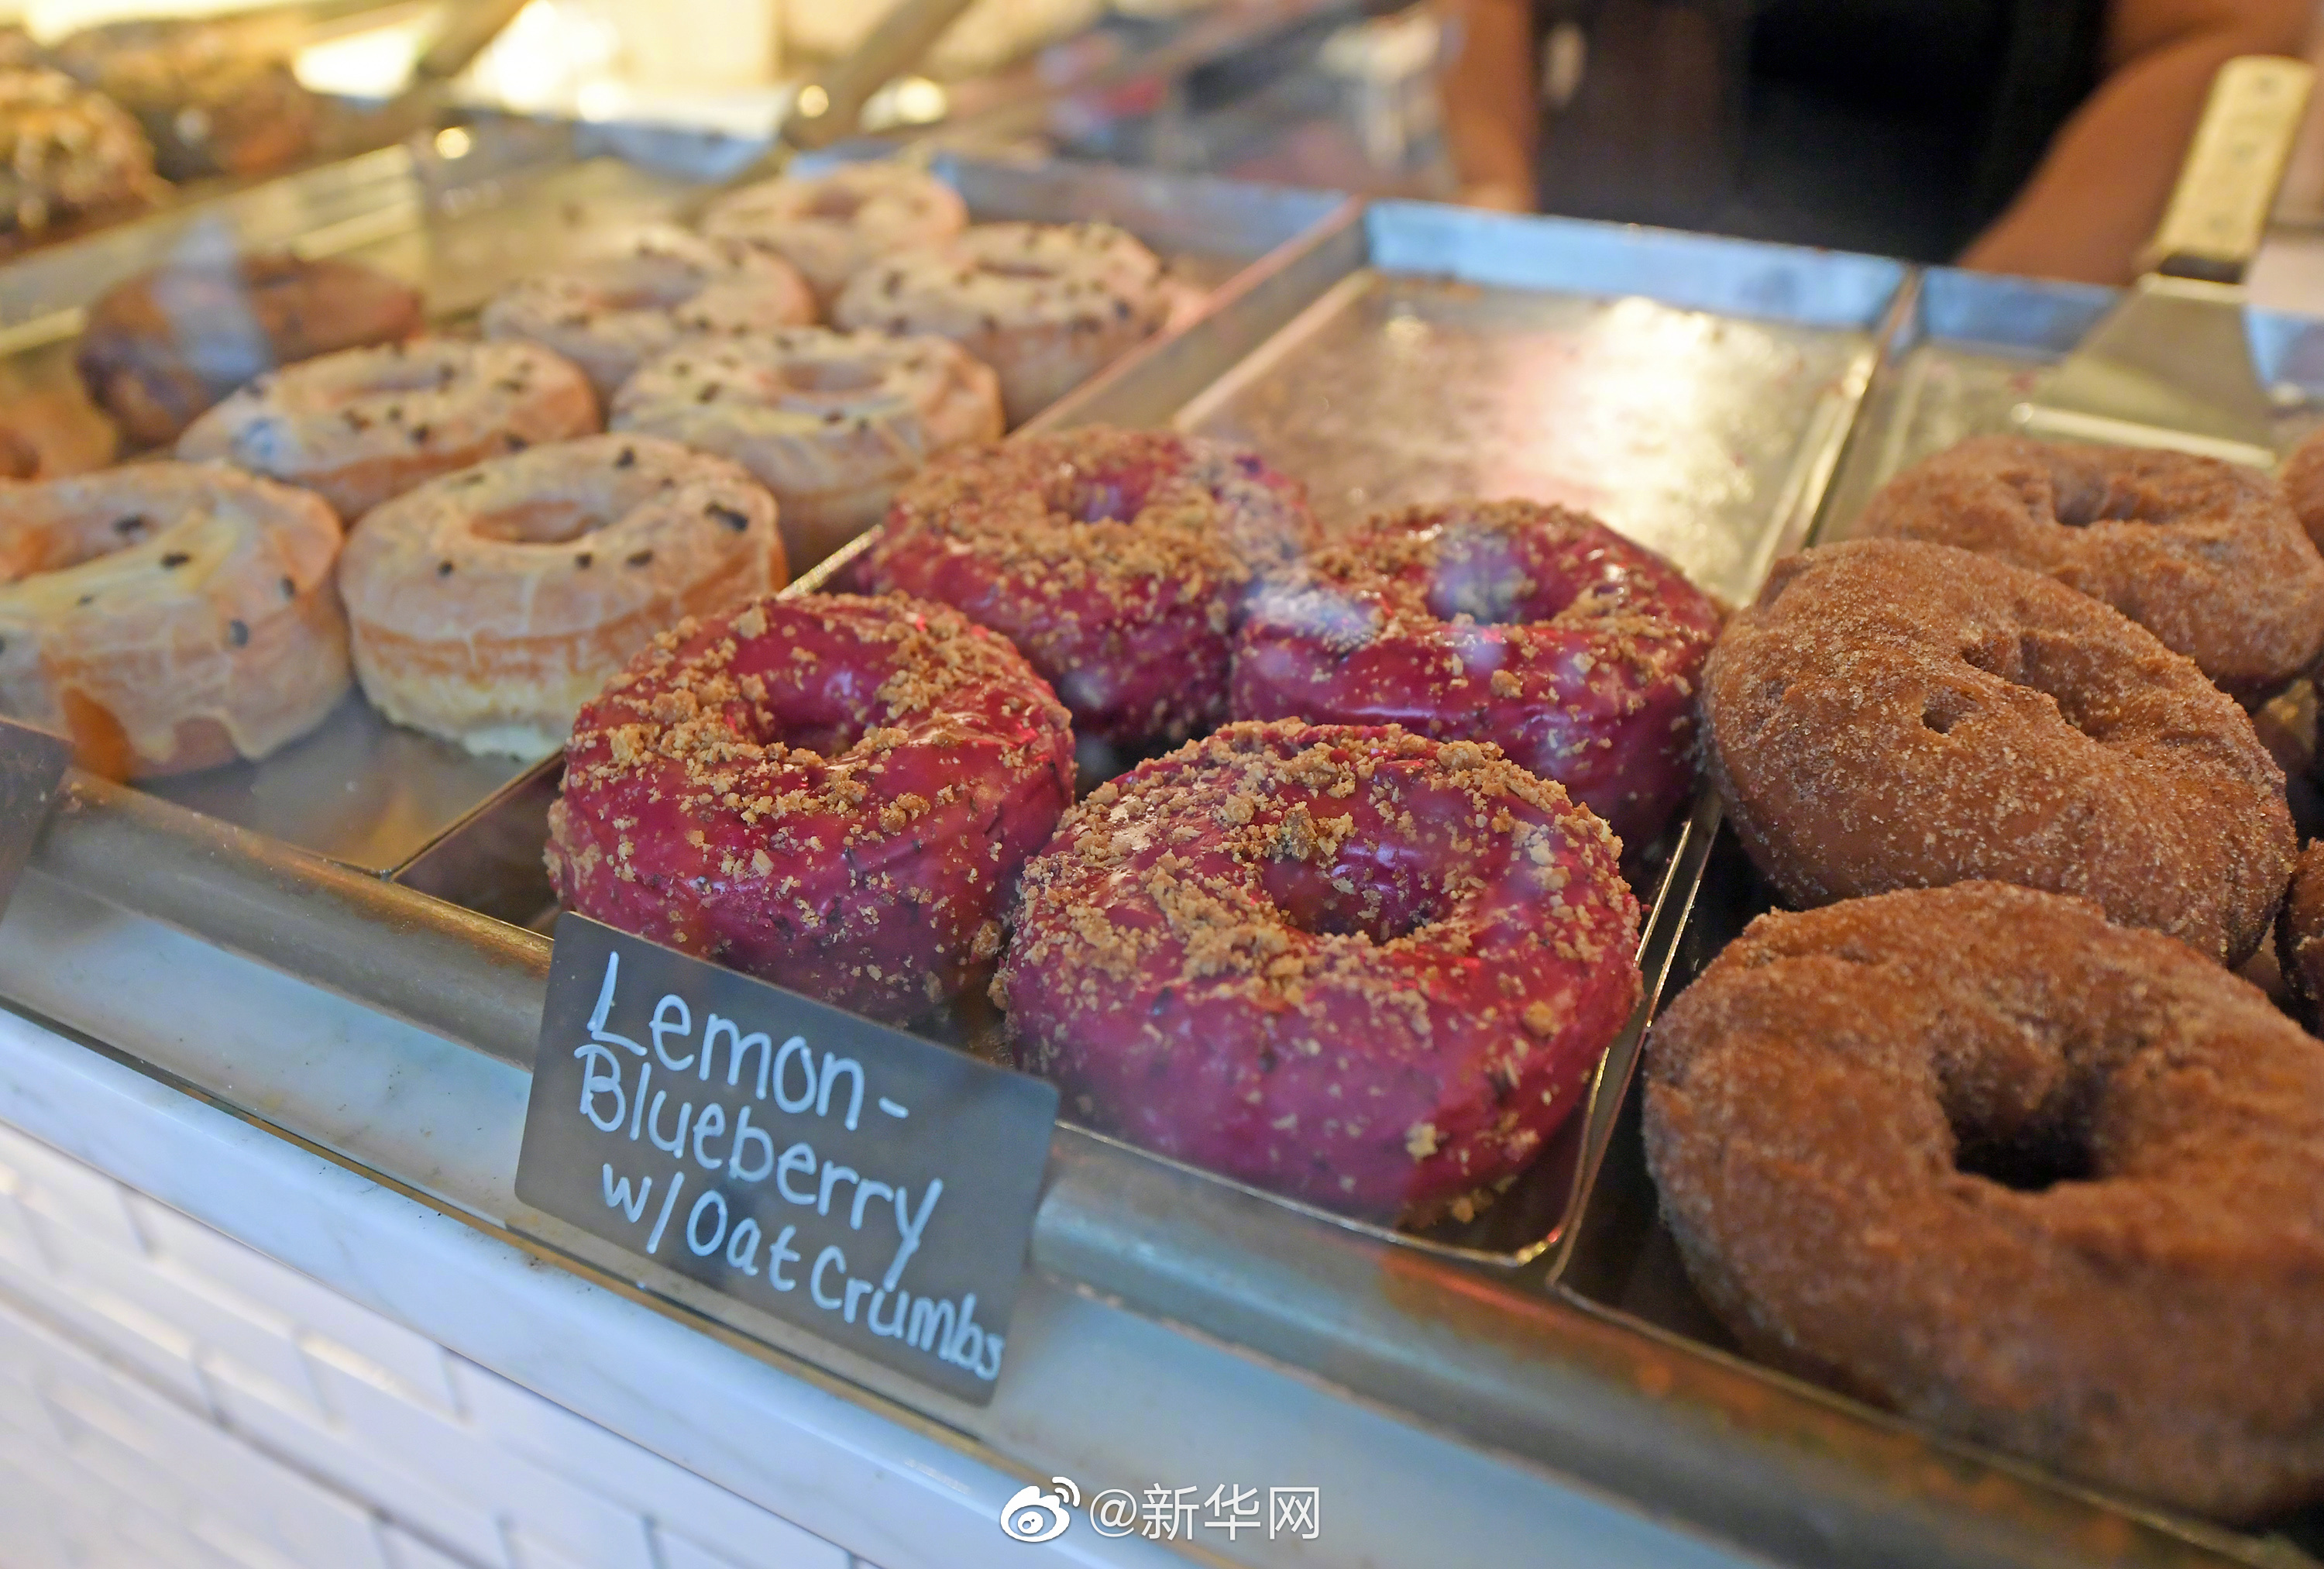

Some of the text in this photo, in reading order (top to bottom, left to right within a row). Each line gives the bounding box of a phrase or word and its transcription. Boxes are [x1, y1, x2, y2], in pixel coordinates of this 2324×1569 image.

[586, 950, 909, 1130] Lemon-
[573, 1043, 944, 1292] Blueberry
[810, 1245, 1005, 1381] Crumbs
